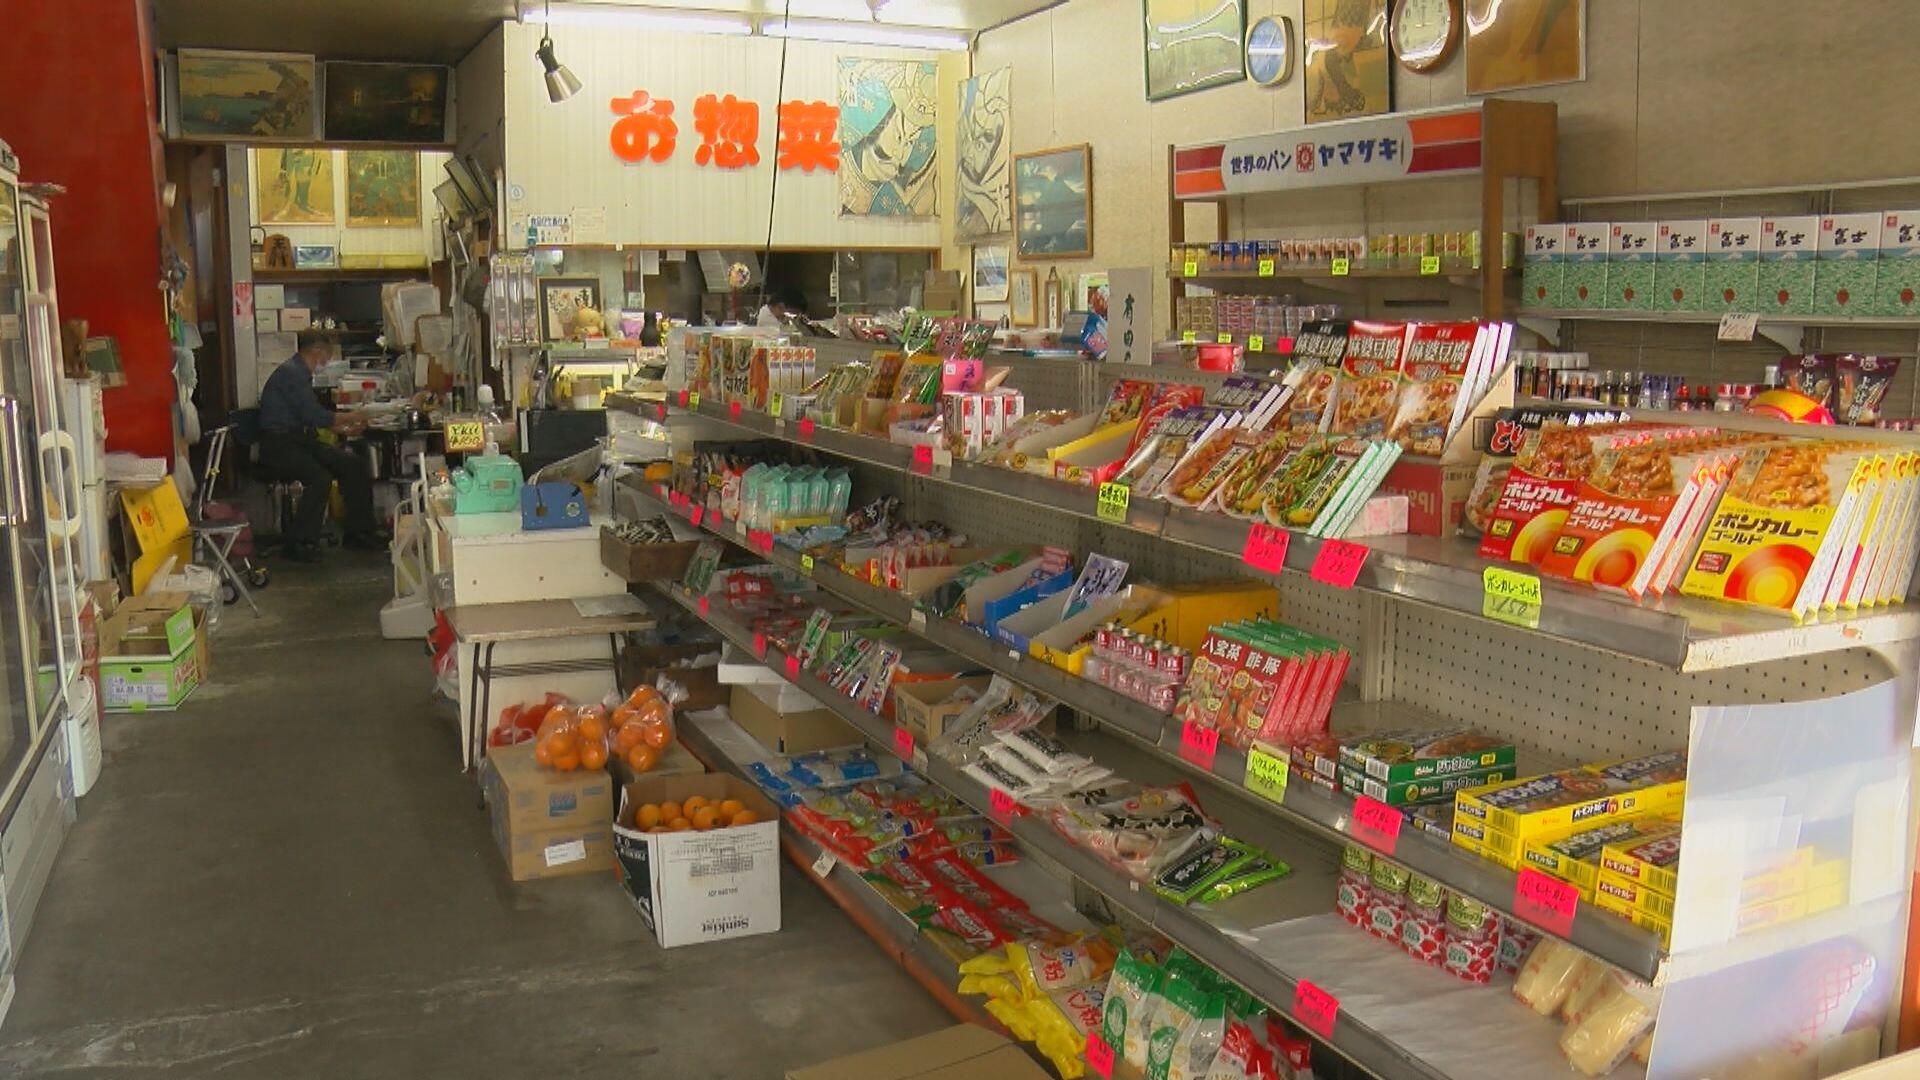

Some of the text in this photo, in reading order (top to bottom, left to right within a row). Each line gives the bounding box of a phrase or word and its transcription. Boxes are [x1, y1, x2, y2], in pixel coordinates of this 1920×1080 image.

[610, 89, 842, 174] お惣菜
[1230, 137, 1398, 175] 世界のパン ヤマザキ
[1499, 498, 1543, 513] ゴールド
[1572, 500, 1662, 524] ボンカレー
[1567, 515, 1615, 532] ゴールド
[1713, 512, 1819, 538] ボンカレー
[1708, 530, 1763, 545] ゴールド
[1201, 636, 1243, 662] 八宝菜
[701, 917, 749, 934] Sunkist
